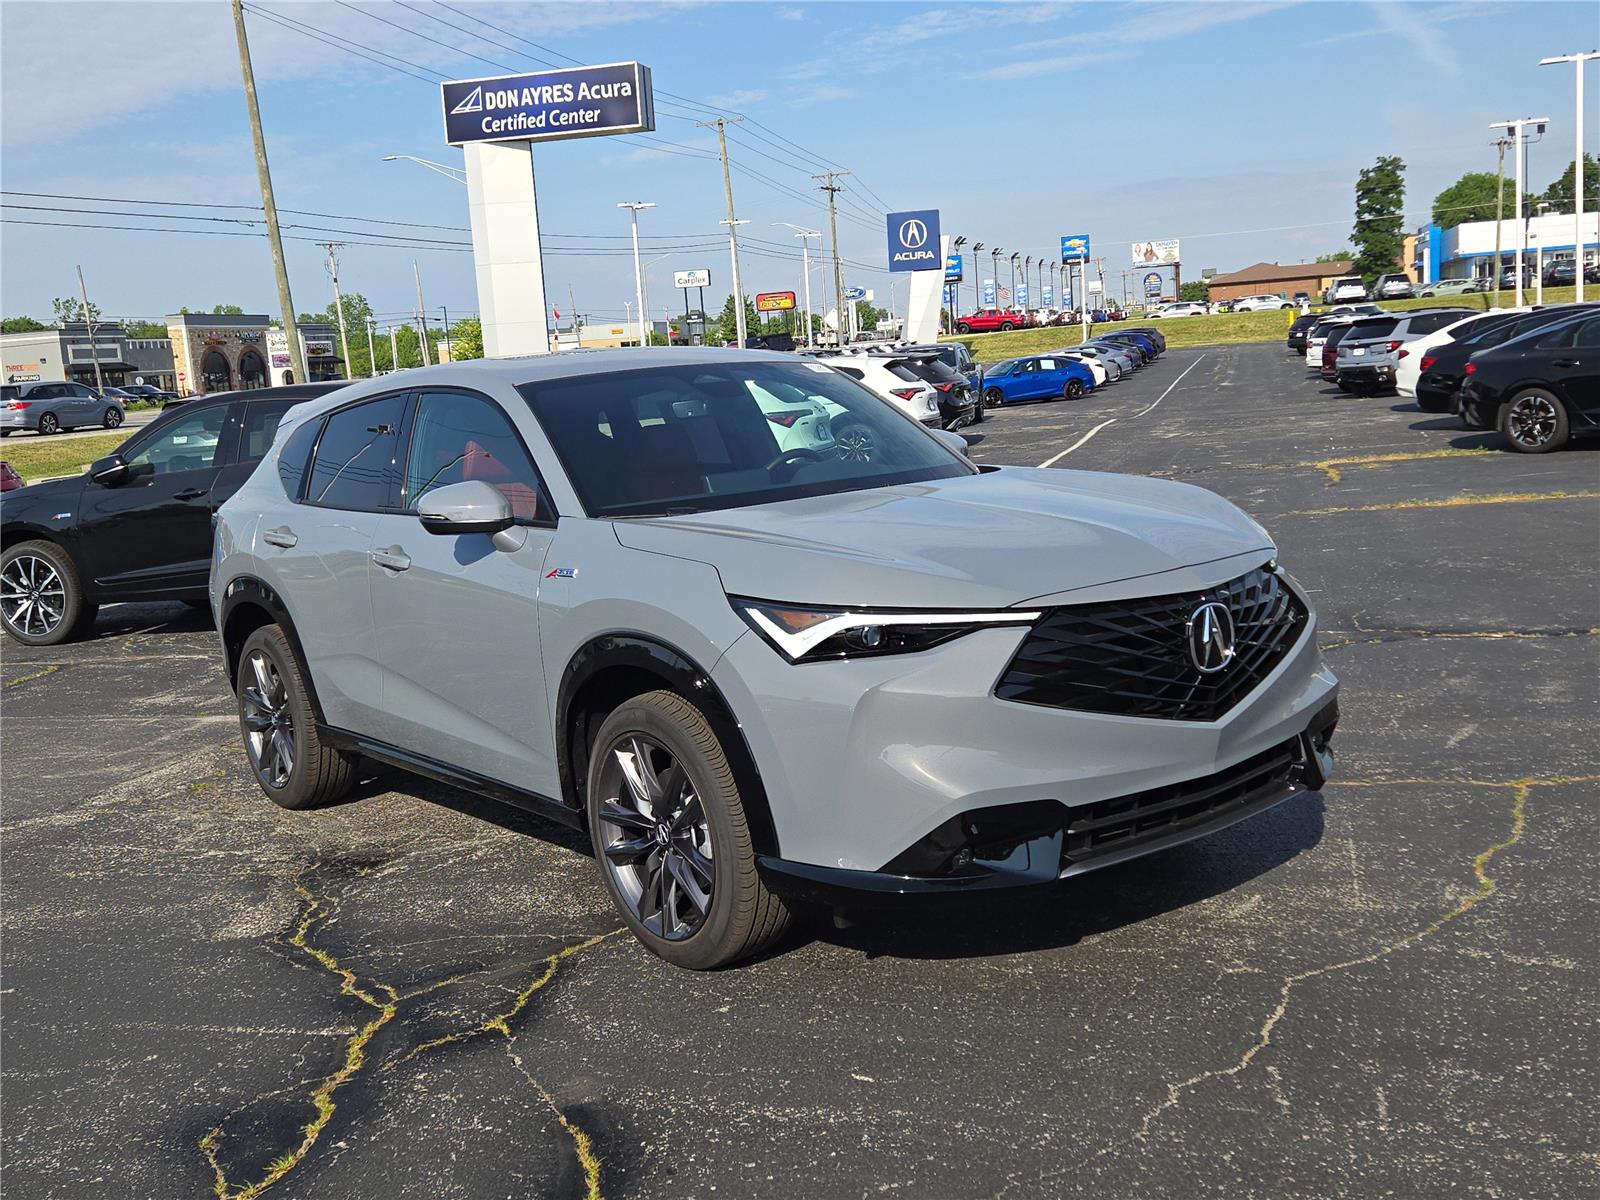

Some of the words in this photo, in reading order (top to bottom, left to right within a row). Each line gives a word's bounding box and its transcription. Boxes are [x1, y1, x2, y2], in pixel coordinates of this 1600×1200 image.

[485, 90, 519, 110] DON
[521, 84, 573, 107] AYRES
[577, 81, 632, 101] Acura
[481, 112, 546, 133] Certified
[549, 108, 600, 126] Center
[893, 250, 935, 262] ACURA
[677, 276, 706, 285] Carplex
[5, 364, 24, 372] THREE
